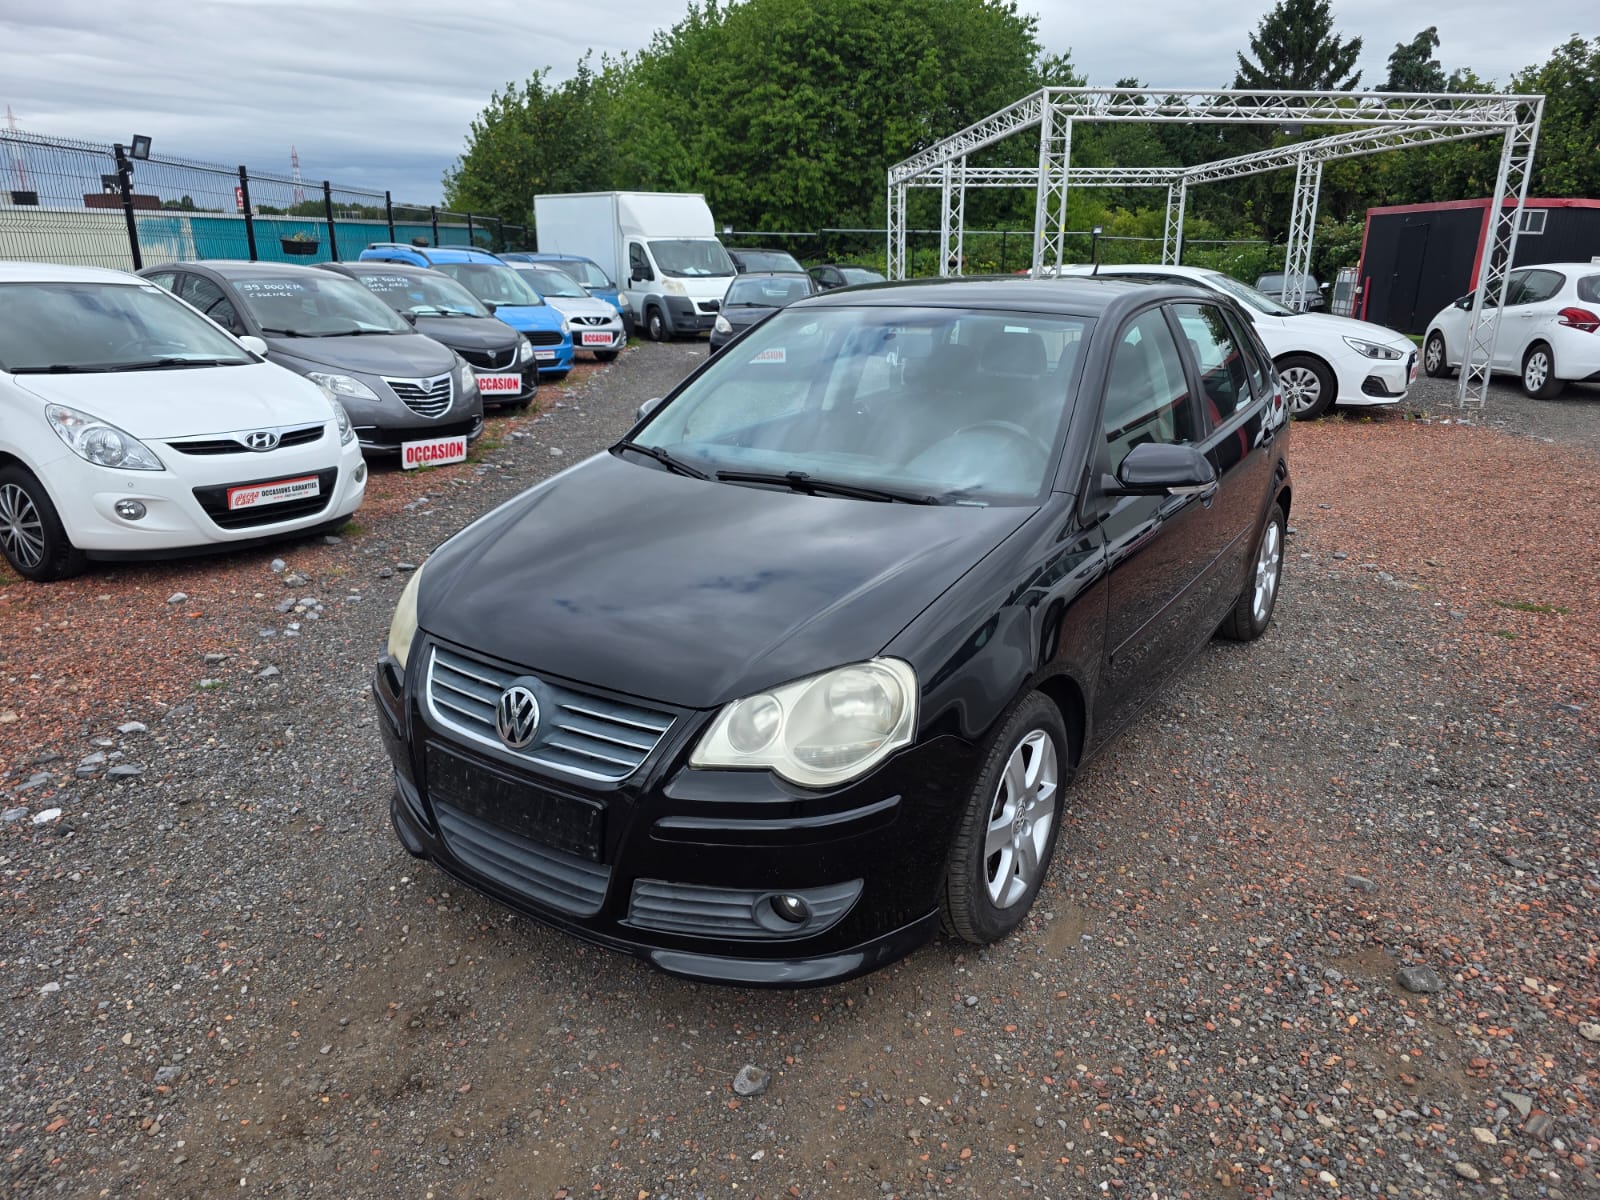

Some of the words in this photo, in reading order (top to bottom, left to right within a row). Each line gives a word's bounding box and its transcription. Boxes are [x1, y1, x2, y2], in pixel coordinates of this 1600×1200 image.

[584, 333, 611, 343] OCCASION
[406, 441, 464, 463] OCCASION
[261, 486, 292, 497] OCCASIONS
